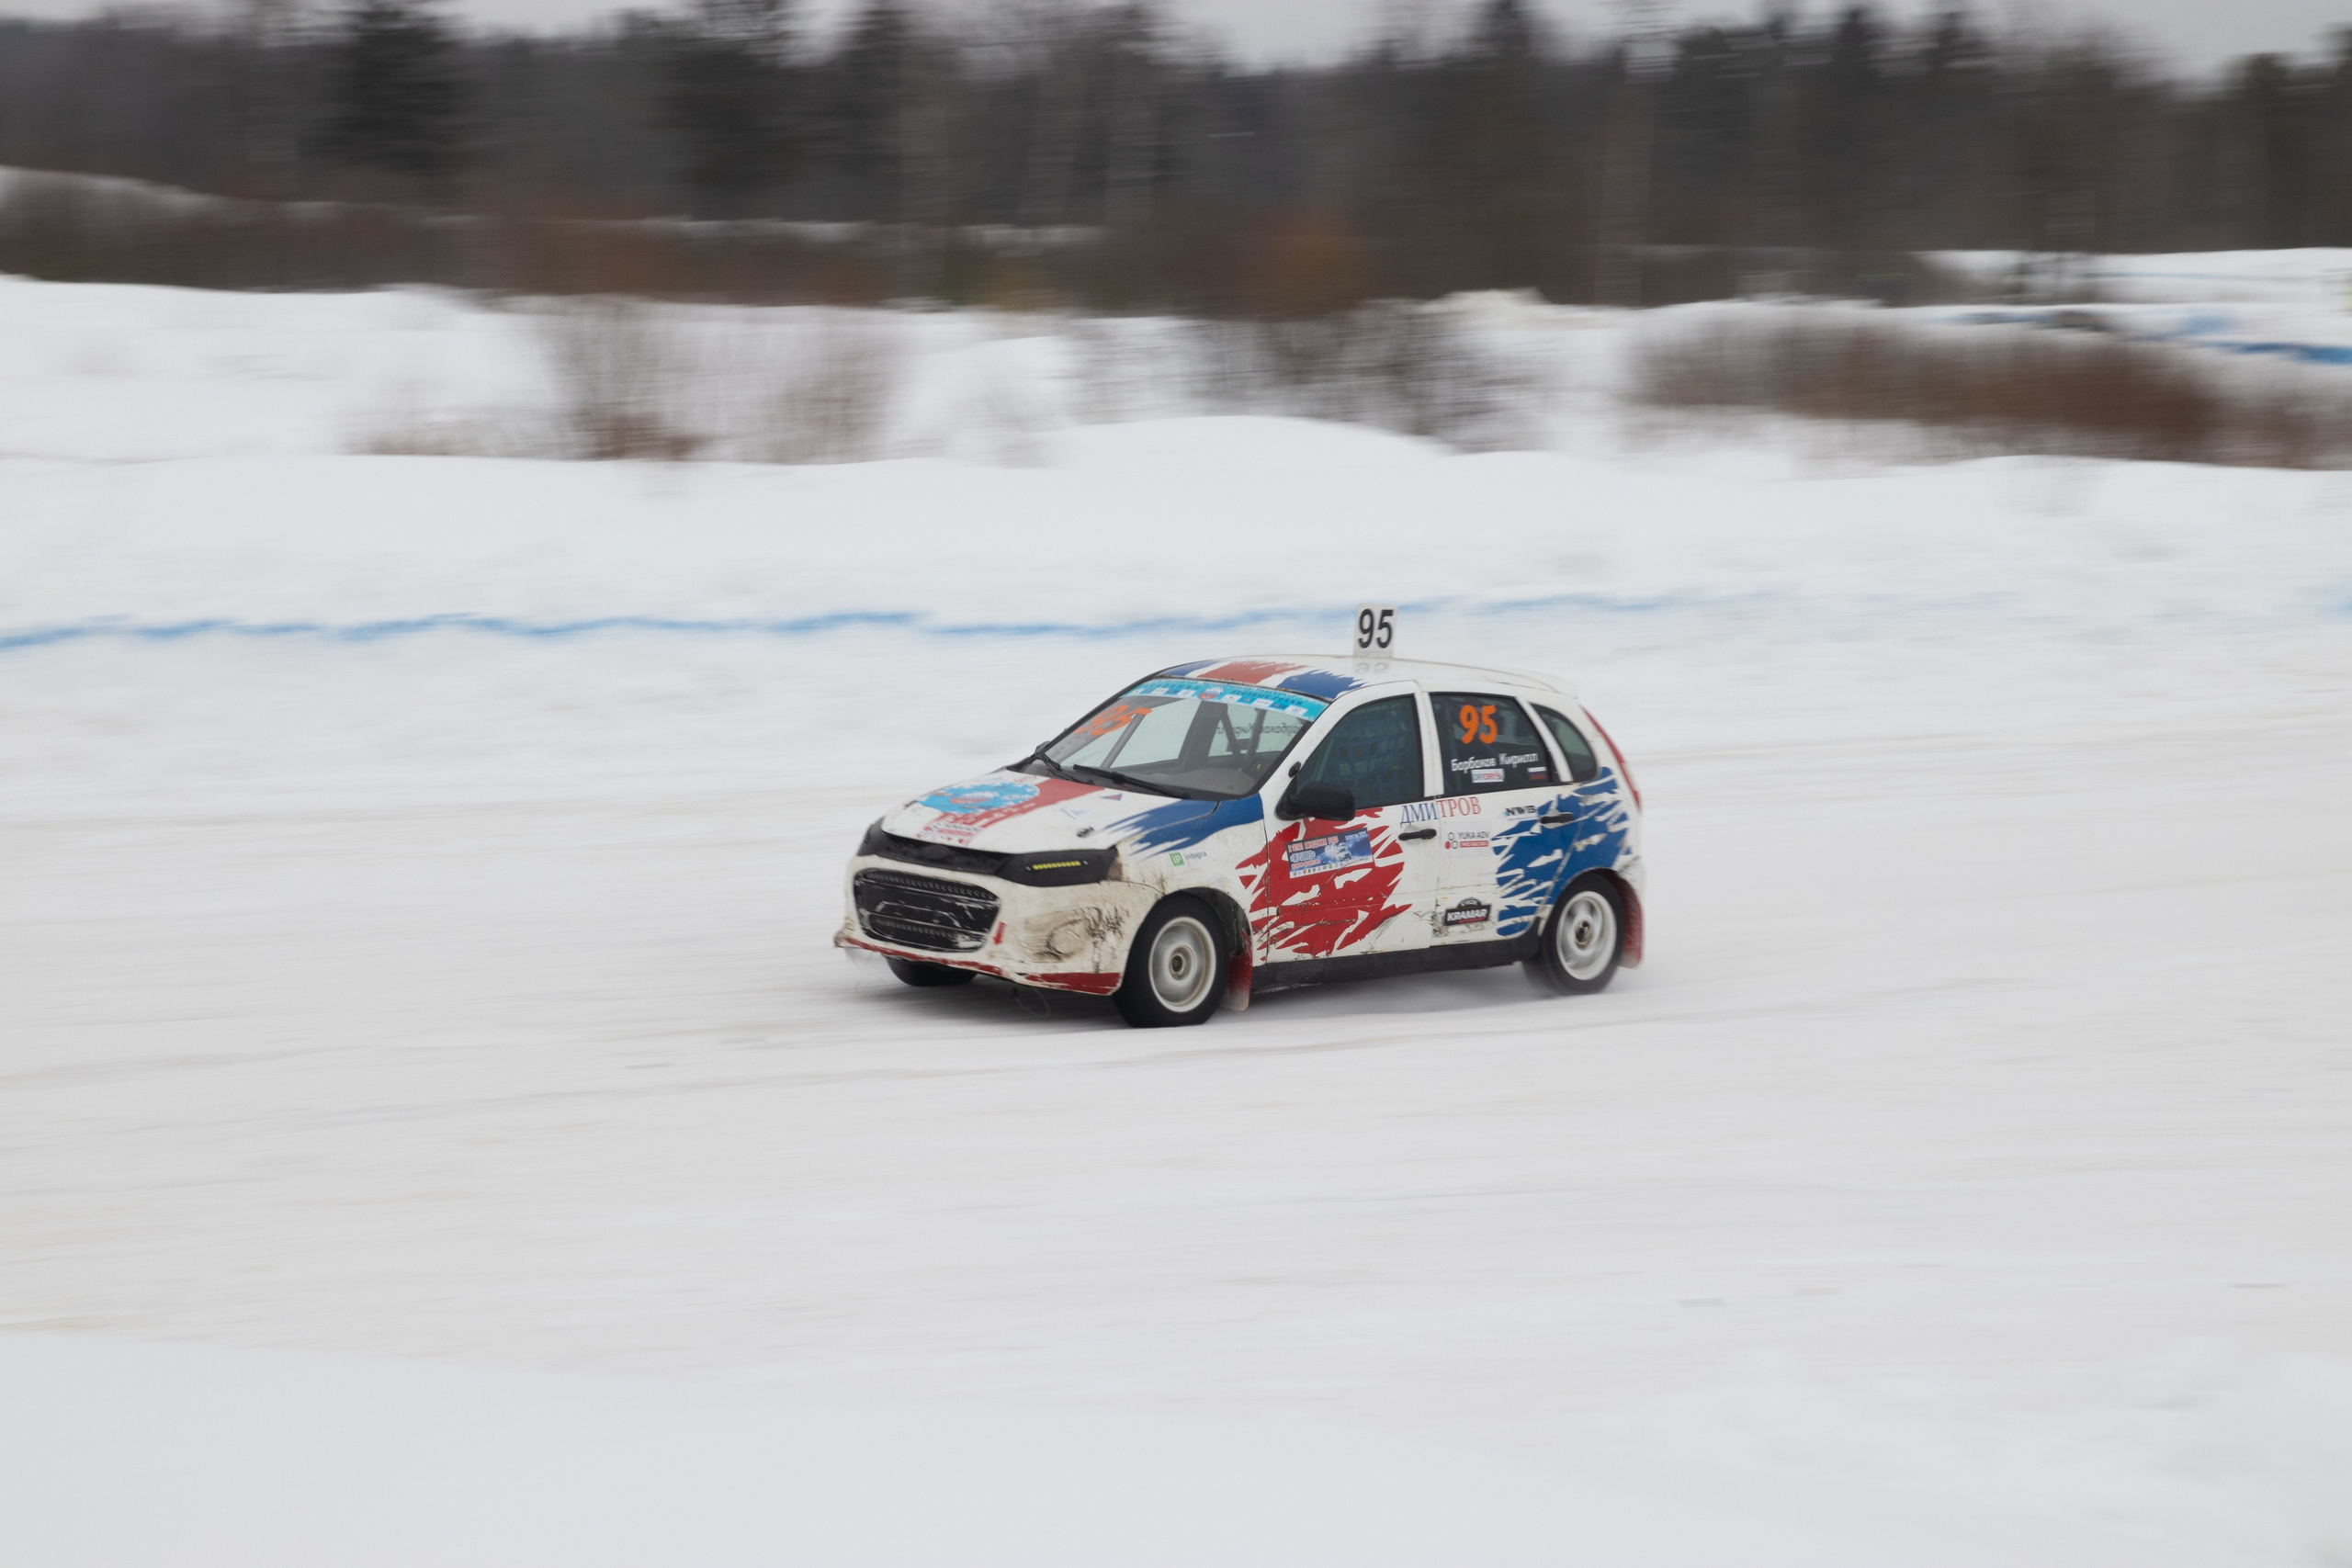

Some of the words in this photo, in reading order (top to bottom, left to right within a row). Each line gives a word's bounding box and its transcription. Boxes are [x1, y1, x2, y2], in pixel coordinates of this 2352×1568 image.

[1358, 608, 1394, 649] 95
[1073, 704, 1153, 737] 95
[1459, 705, 1498, 744] 95
[1498, 753, 1539, 768] Кирилл
[1400, 796, 1482, 829] ДМИТРОВ
[1447, 908, 1488, 921] KRAMAR
